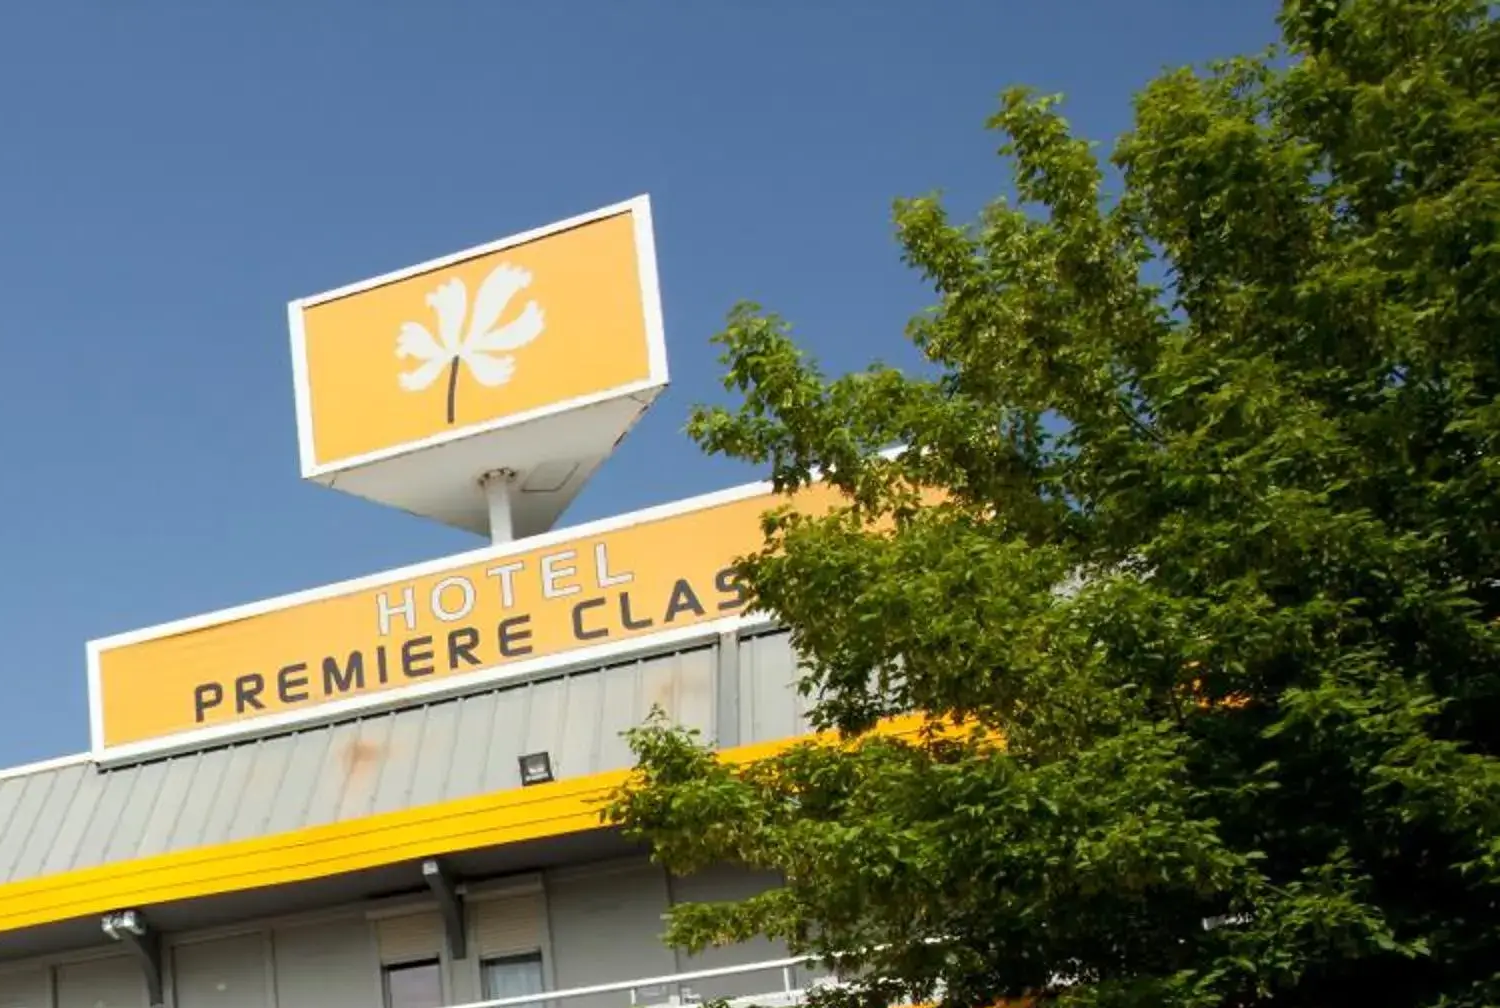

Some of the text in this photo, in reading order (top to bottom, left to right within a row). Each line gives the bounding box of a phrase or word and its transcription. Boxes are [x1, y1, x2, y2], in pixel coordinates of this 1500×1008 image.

[193, 567, 751, 723] PREMIERE CLAS
[376, 542, 634, 636] HOTEL
